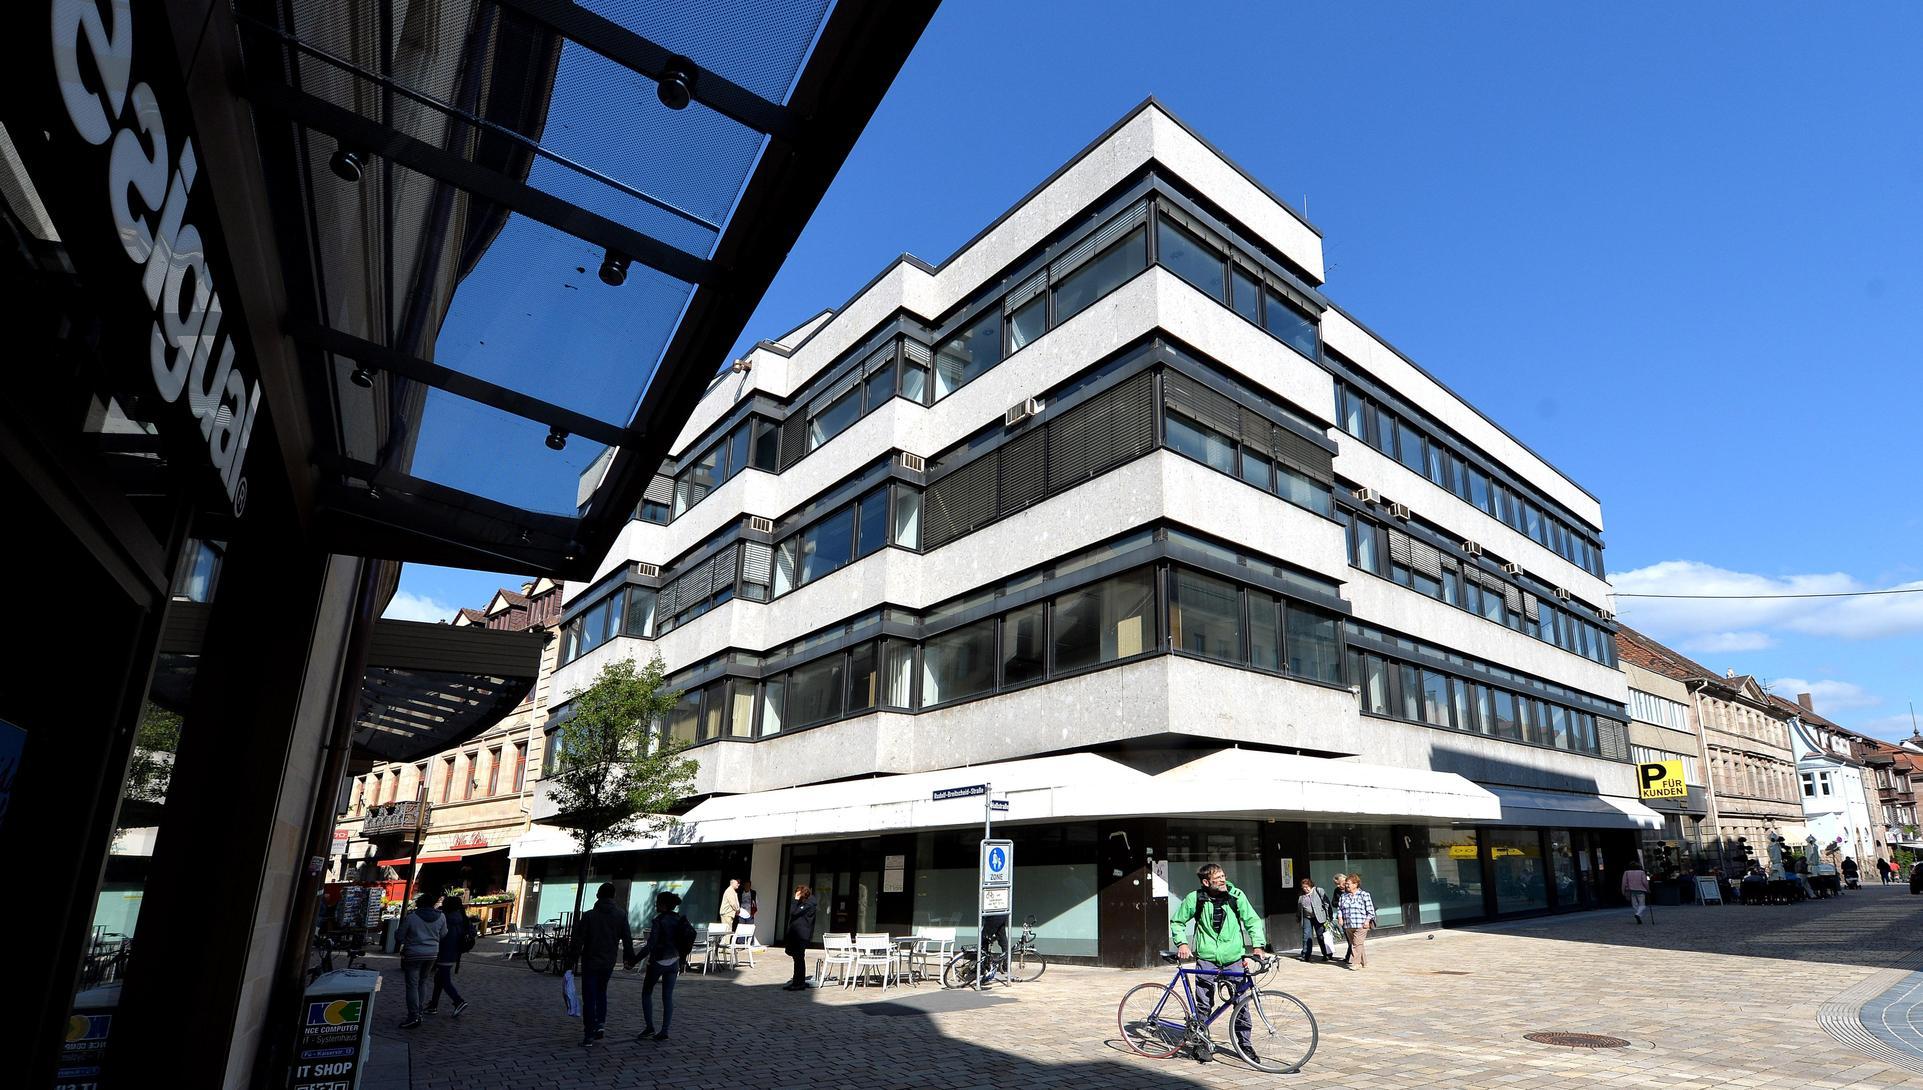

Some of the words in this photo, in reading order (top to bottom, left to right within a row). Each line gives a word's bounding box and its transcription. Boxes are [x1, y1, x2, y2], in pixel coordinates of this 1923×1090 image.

[1640, 764, 1667, 789] P
[1662, 779, 1683, 788] FÜR
[1643, 787, 1683, 798] KUNDEN
[990, 873, 1003, 881] ZONE
[304, 1027, 319, 1035] NCE
[320, 1025, 359, 1034] COMPUTER
[317, 1034, 358, 1045] Systemhaus
[296, 1065, 311, 1079] IT
[313, 1062, 353, 1077] SHOP
